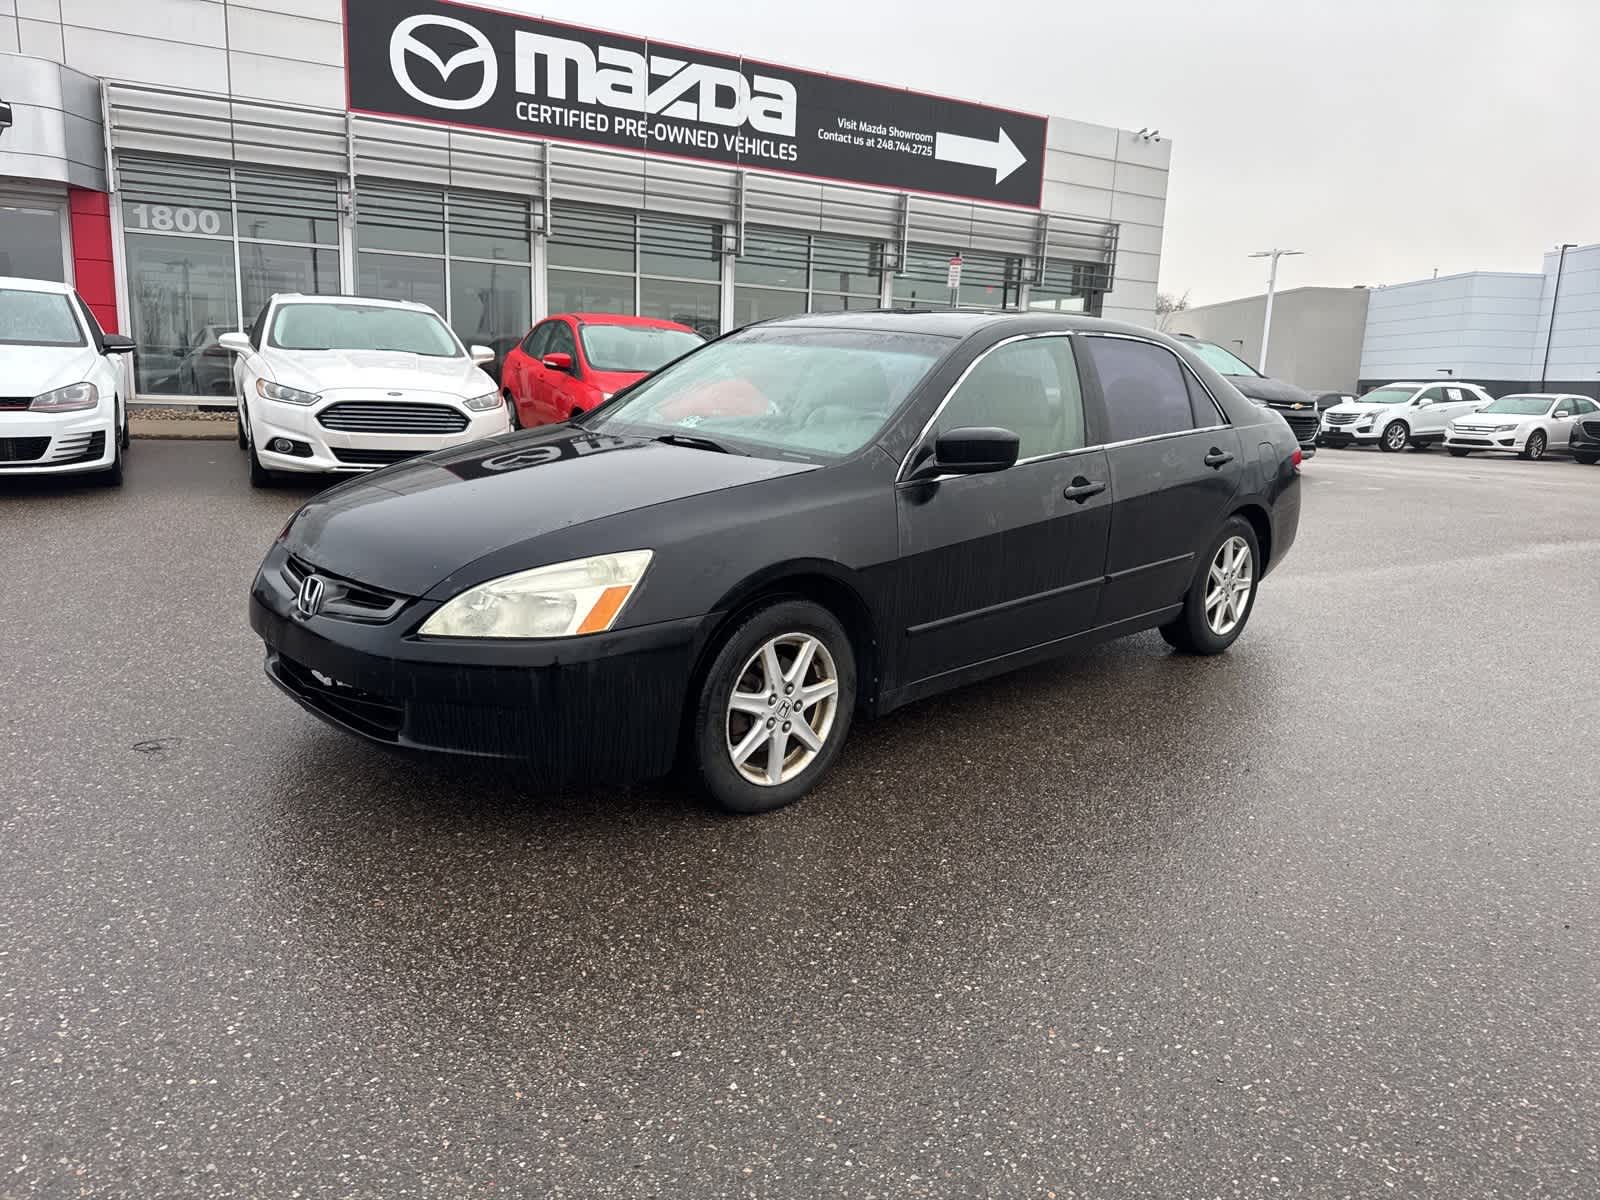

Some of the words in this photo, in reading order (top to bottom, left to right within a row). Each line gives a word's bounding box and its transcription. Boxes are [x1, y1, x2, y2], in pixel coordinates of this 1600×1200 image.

[515, 30, 797, 136] mazda
[516, 101, 609, 132] CERTIFIED
[614, 116, 719, 149] PRE-OWNED
[723, 134, 798, 161] VEHICLES
[817, 128, 852, 144] Contact
[853, 135, 864, 146] us
[865, 137, 875, 148] at
[876, 138, 933, 156] 248.744.2725
[837, 116, 857, 131] Visit
[859, 120, 887, 136] Mazda
[888, 126, 934, 143] Showroom
[132, 203, 221, 234] 1800
